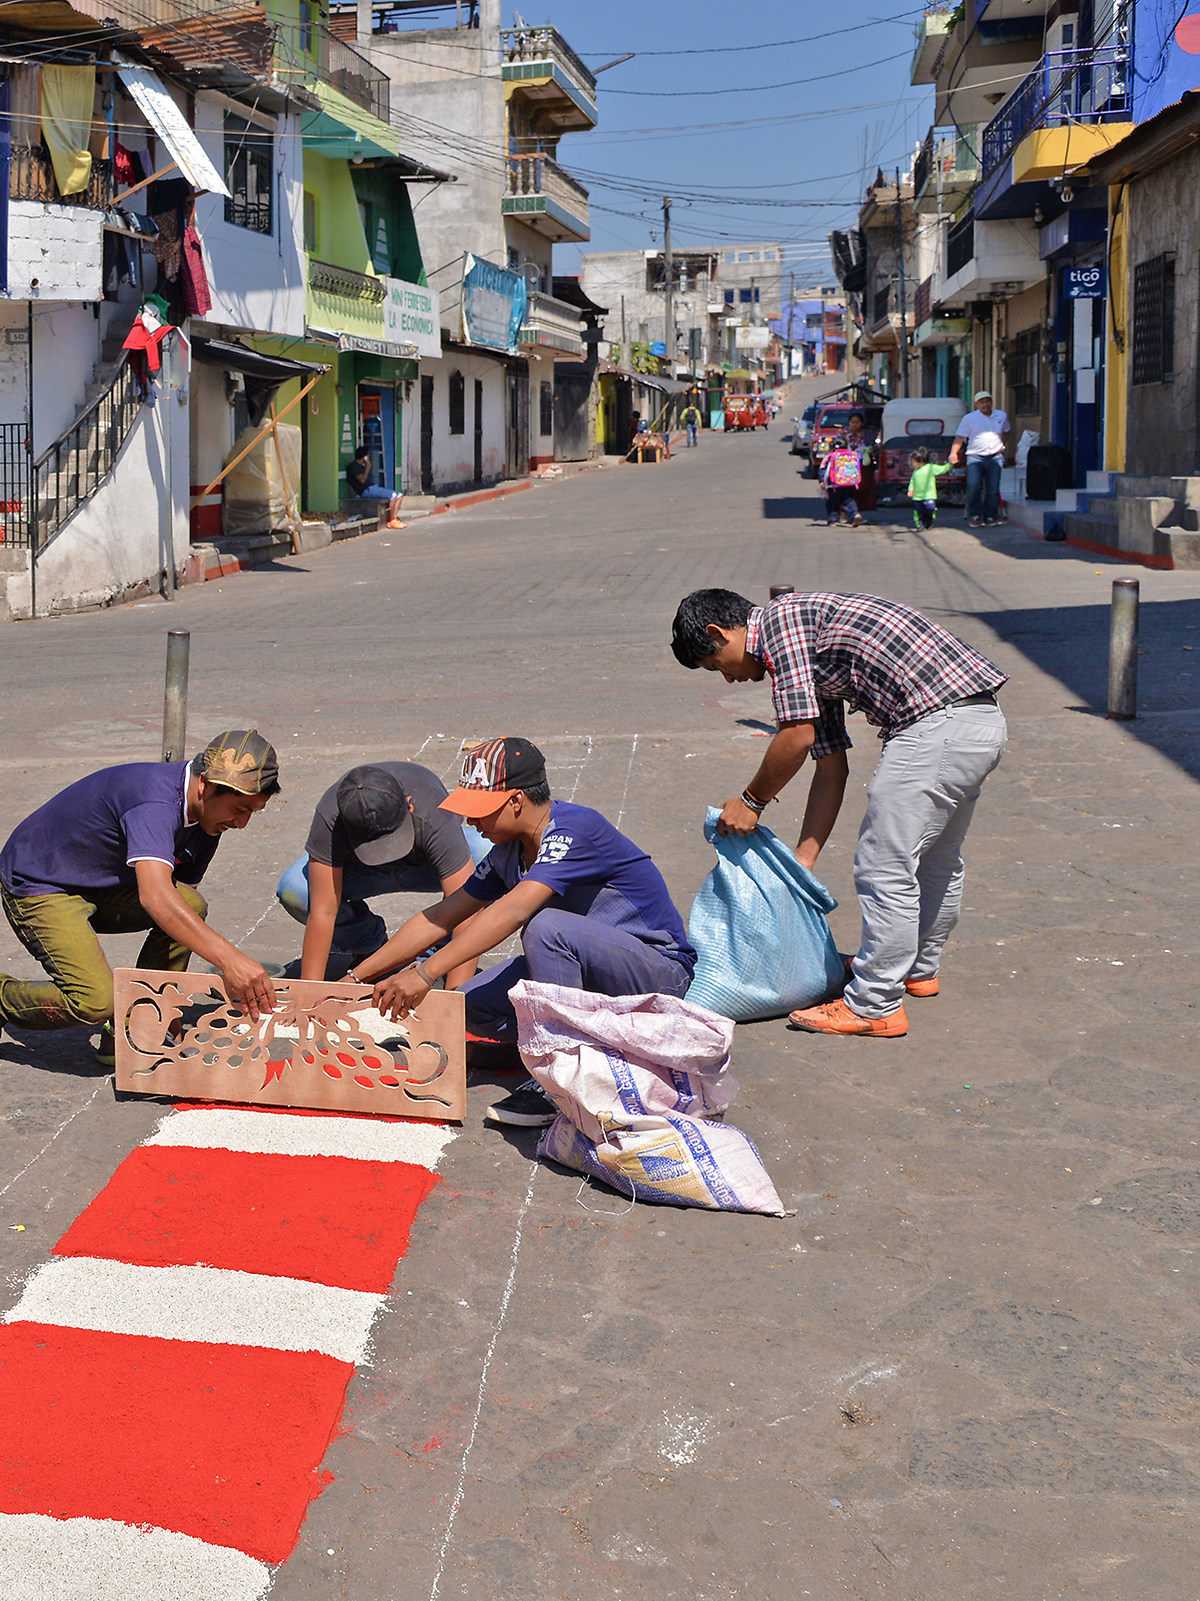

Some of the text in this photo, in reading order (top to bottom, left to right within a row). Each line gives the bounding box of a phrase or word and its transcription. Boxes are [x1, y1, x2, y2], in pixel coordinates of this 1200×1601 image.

[404, 291, 432, 313] FERRETERIA
[388, 310, 434, 336] LA ECONOMICA
